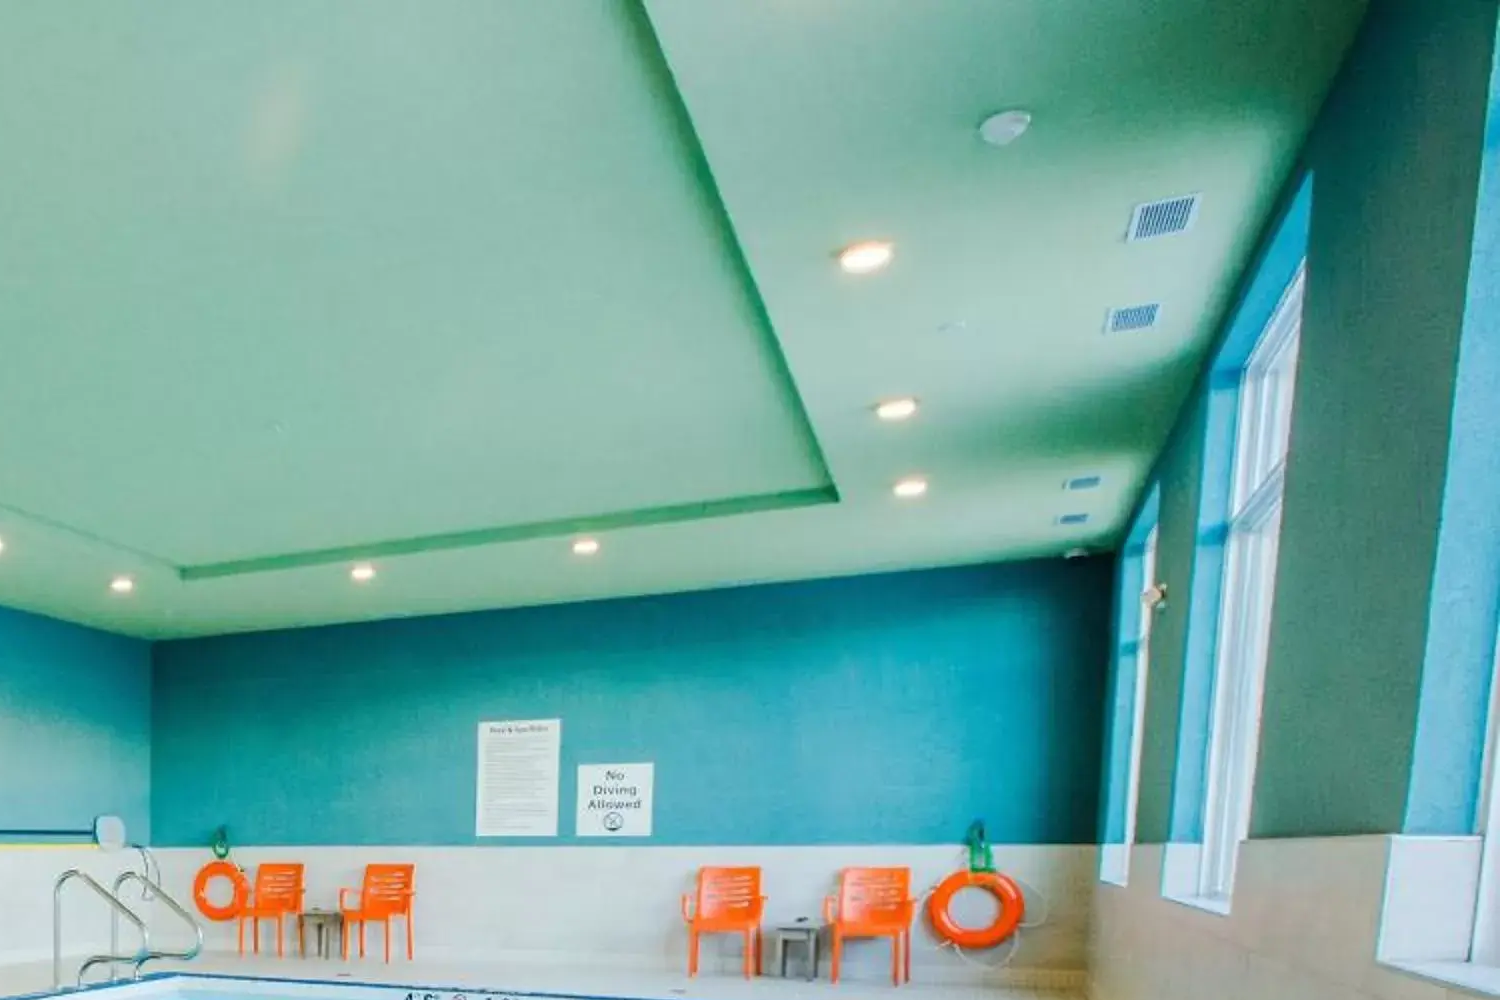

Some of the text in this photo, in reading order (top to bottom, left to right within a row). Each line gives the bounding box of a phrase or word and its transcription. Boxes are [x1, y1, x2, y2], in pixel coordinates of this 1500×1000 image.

[605, 770, 624, 781] No
[592, 785, 637, 797] Diving
[587, 799, 641, 810] Allowed
